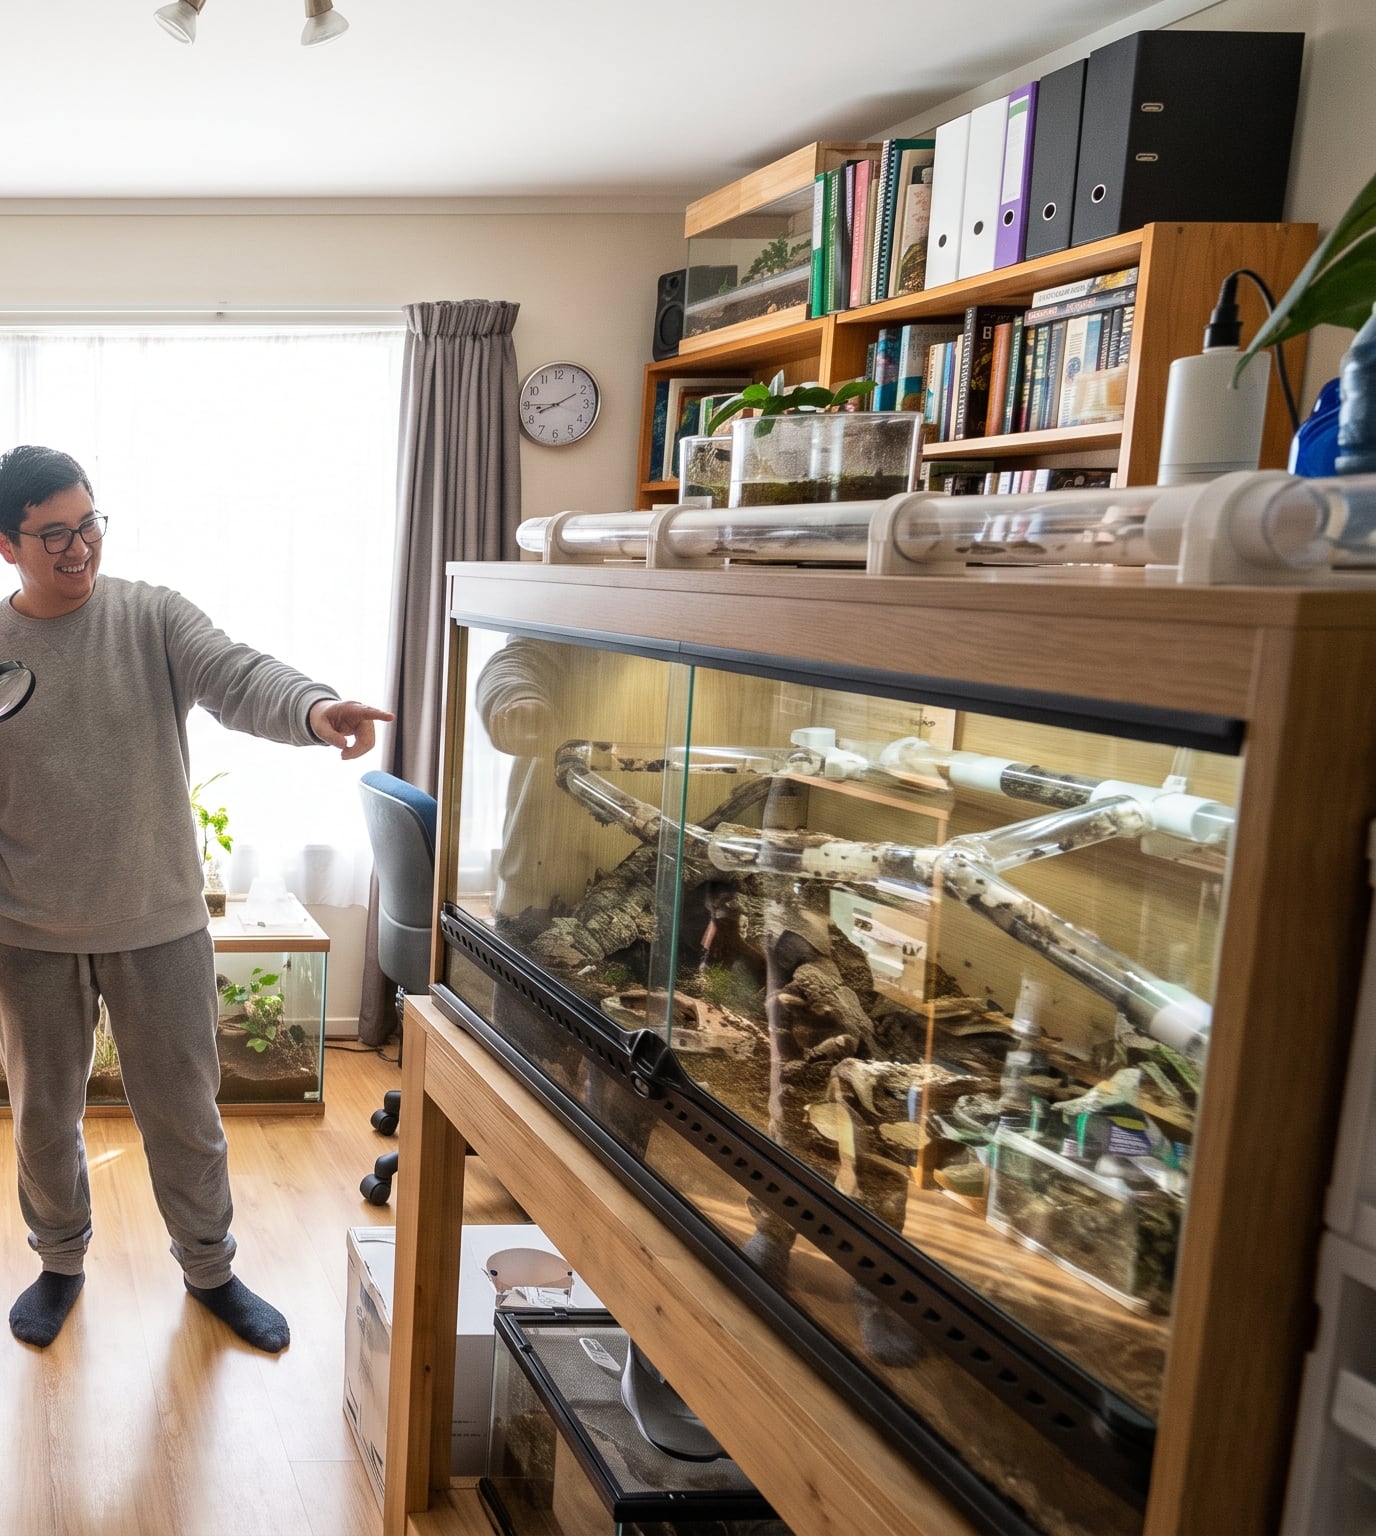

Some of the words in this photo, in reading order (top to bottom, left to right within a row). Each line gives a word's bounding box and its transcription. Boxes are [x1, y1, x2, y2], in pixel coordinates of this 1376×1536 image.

[541, 375, 548, 384] 11
[554, 370, 564, 380] 12
[572, 374, 575, 384] 1
[530, 386, 539, 396] 10
[580, 385, 587, 395] 2
[583, 399, 589, 409] 3
[528, 415, 535, 424] 8
[577, 414, 583, 423] 4
[538, 425, 546, 437] 7
[552, 429, 559, 439] 6
[567, 425, 574, 434] 5
